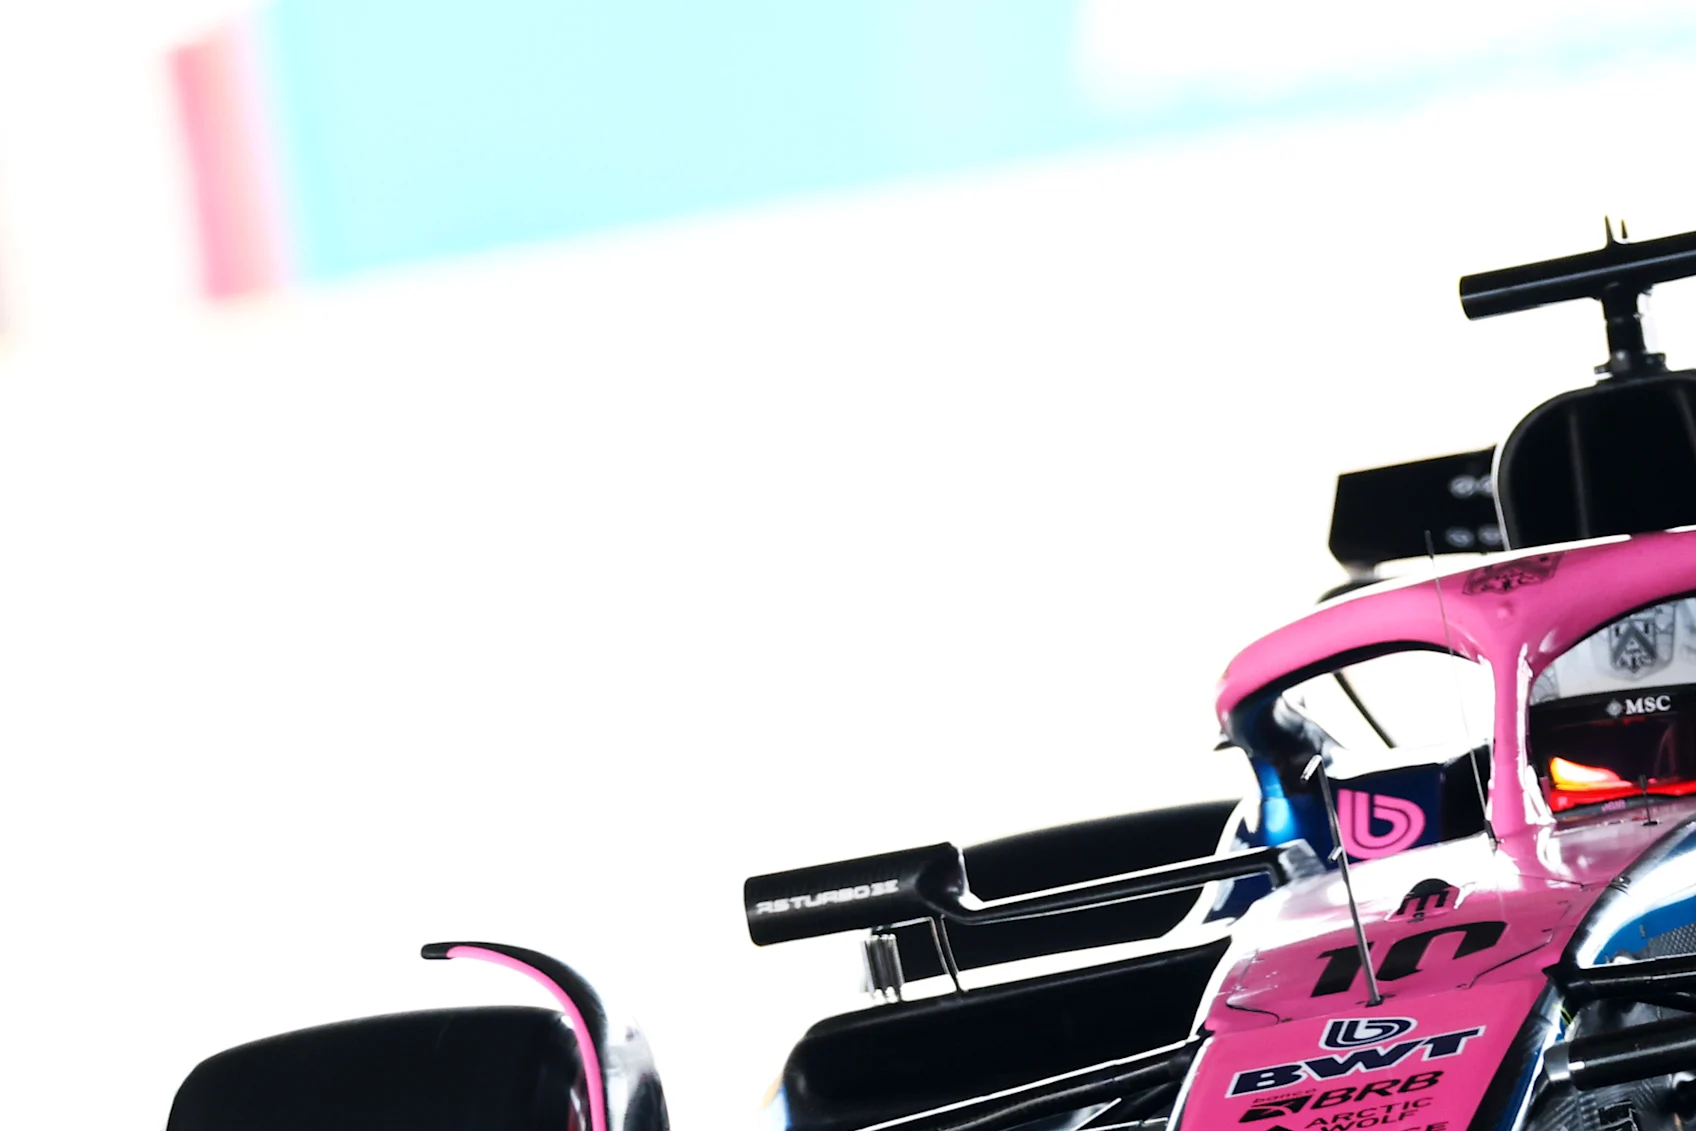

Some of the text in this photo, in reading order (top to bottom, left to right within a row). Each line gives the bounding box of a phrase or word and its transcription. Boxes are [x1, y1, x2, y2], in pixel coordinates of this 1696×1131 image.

[1625, 695, 1671, 715] MSC
[1310, 921, 1507, 998] 10
[1226, 1026, 1486, 1097] BWT
[1311, 1071, 1444, 1110] BRB
[1305, 1097, 1433, 1129] ARCTIC
